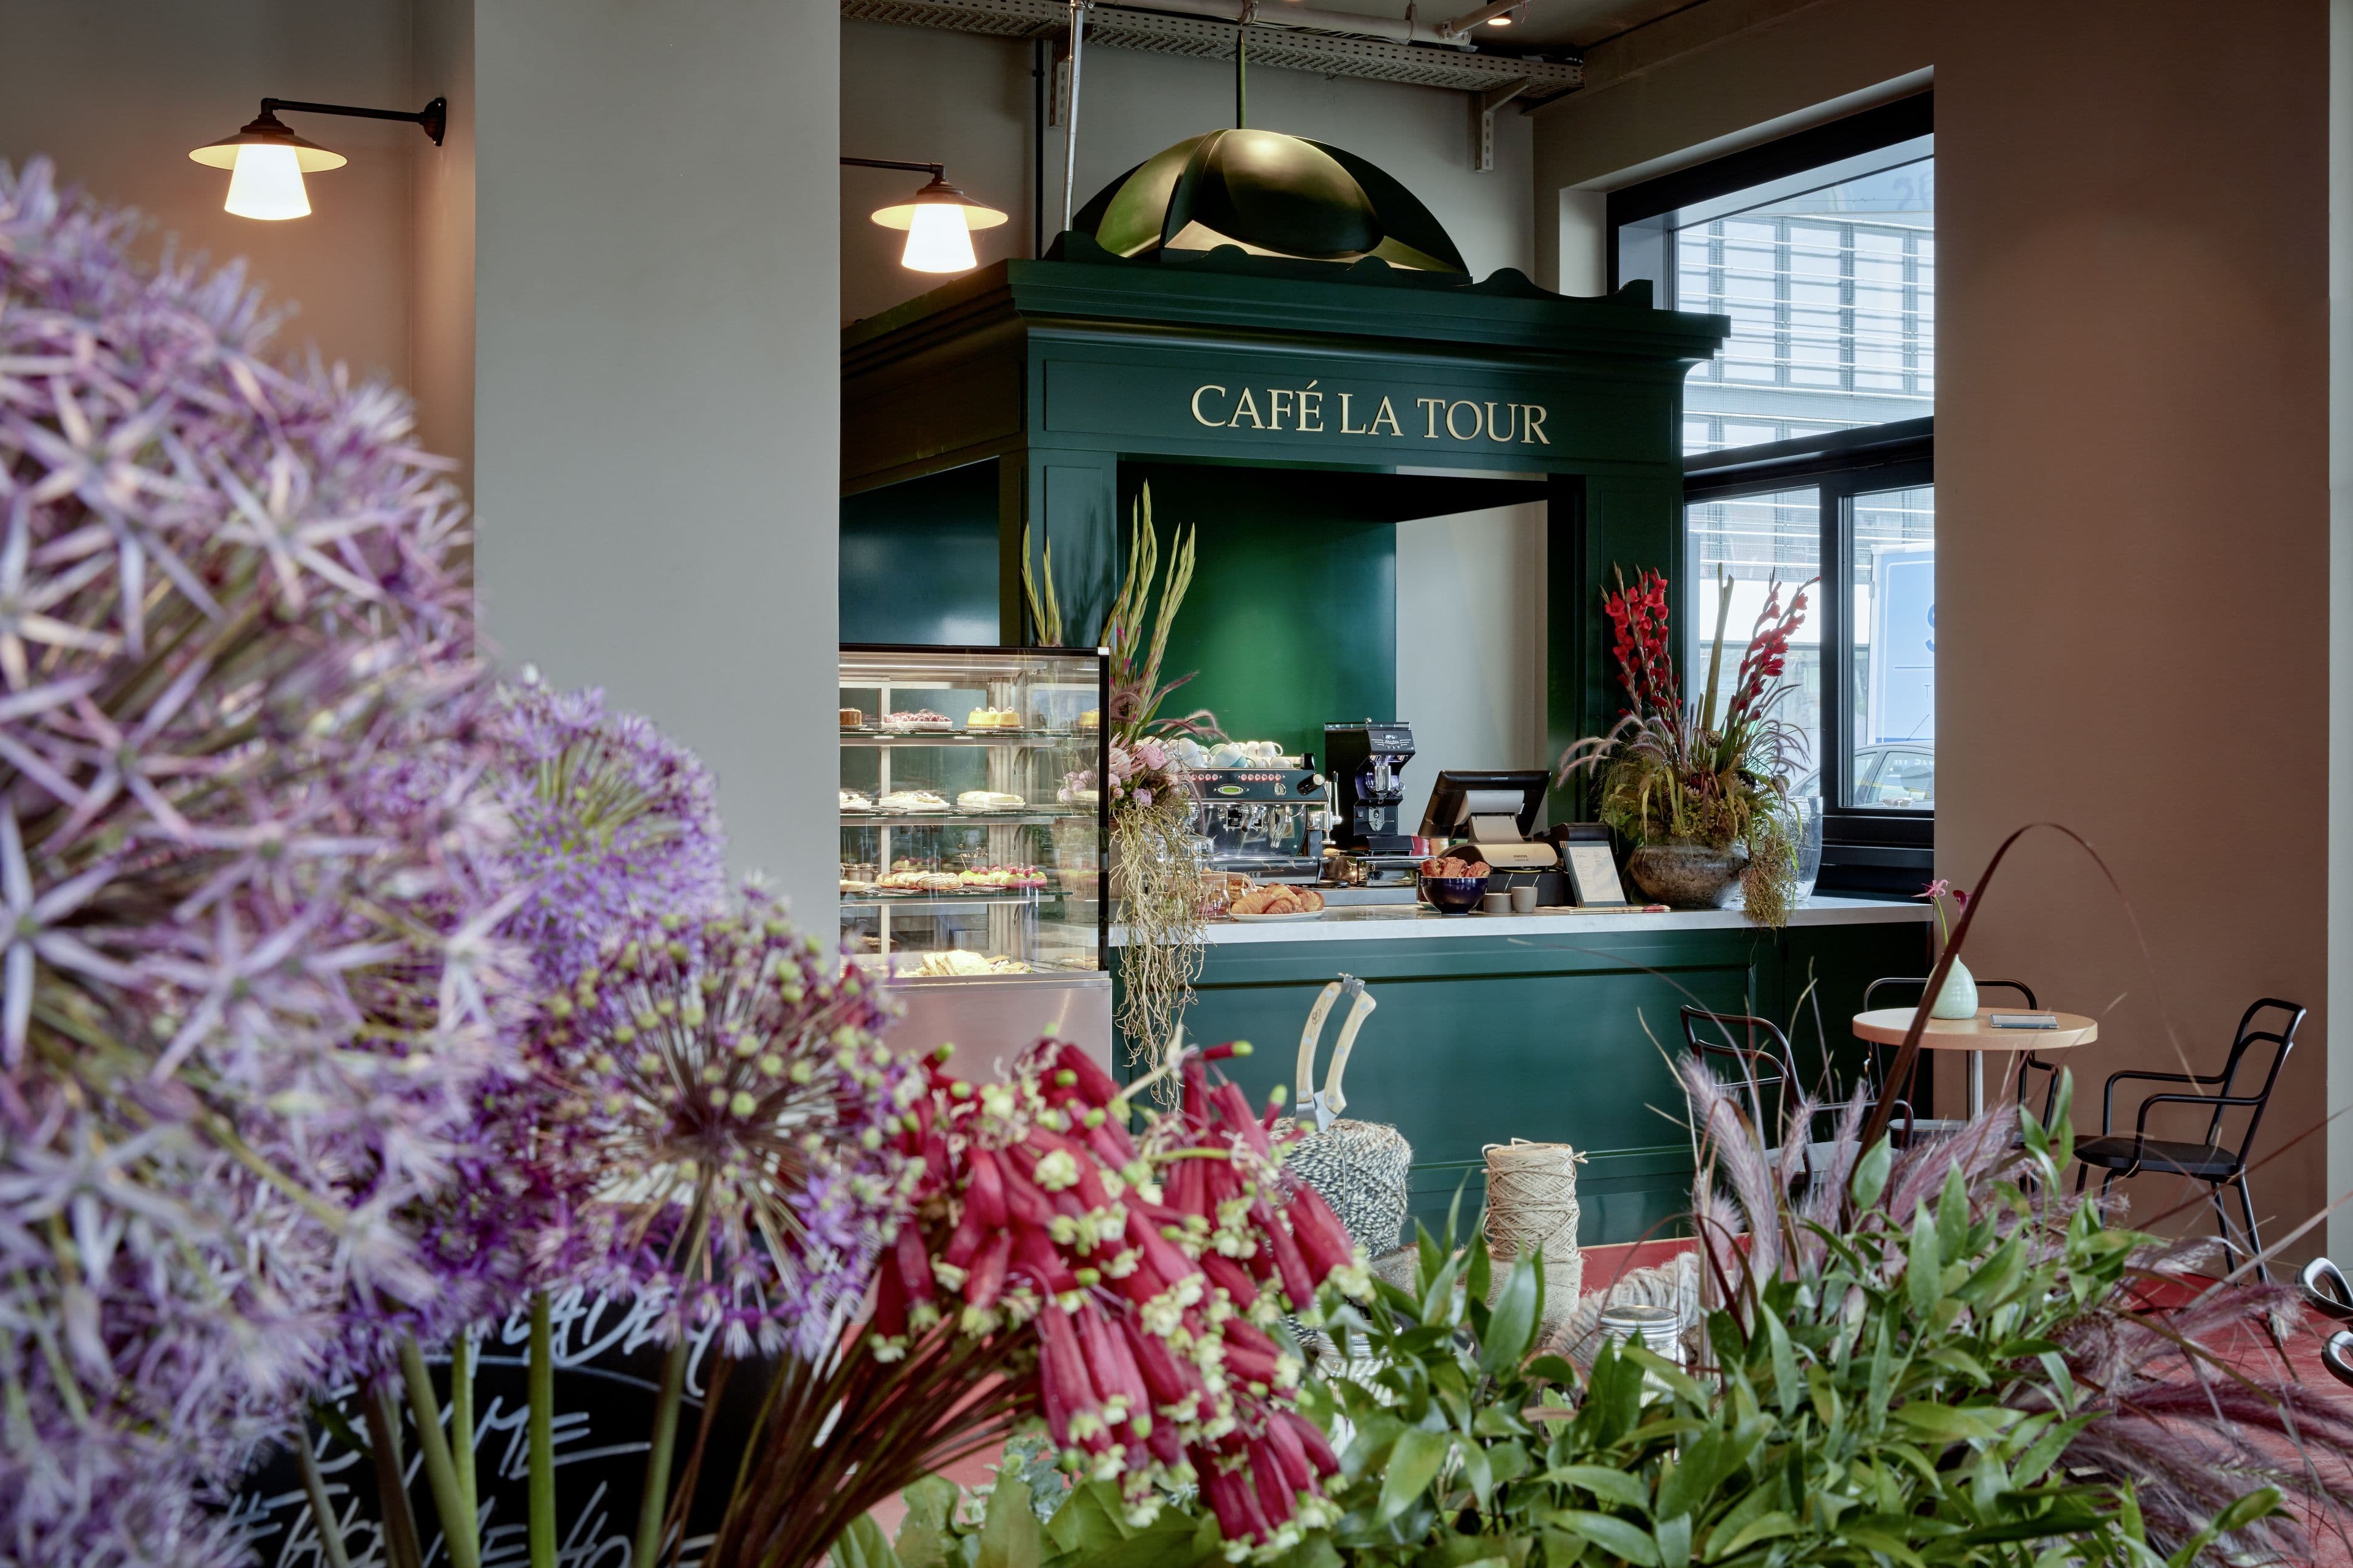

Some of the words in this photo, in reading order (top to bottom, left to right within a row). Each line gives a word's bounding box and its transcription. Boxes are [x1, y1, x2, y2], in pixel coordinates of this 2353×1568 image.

[1191, 379, 1324, 432] CAFÉ
[1337, 393, 1404, 436] LA
[1416, 398, 1551, 444] TOUR
